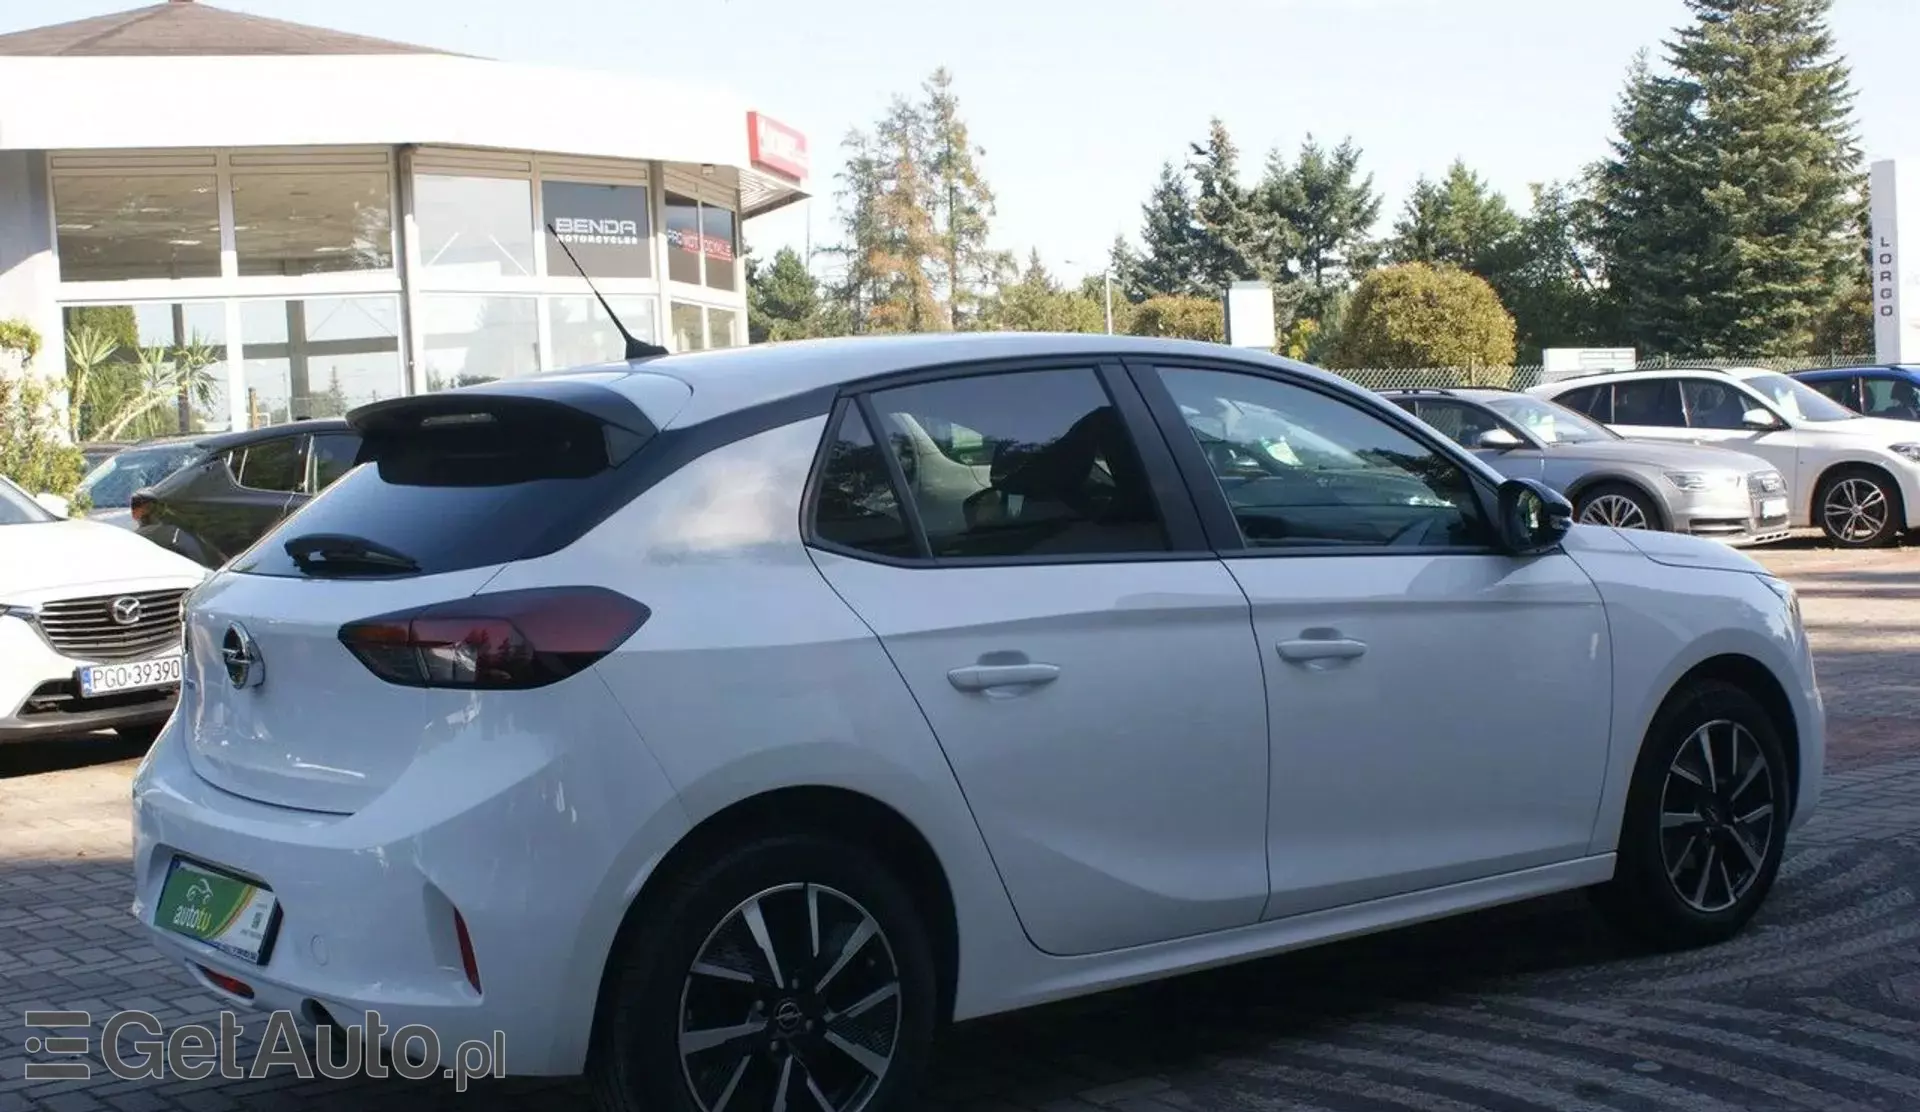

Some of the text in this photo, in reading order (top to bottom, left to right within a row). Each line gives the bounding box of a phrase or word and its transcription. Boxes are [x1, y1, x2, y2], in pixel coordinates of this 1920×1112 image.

[555, 218, 637, 235] BENDA
[556, 234, 638, 245] MOTORCYCLES
[1880, 236, 1893, 317] LORGO
[93, 660, 180, 689] PGO 39390
